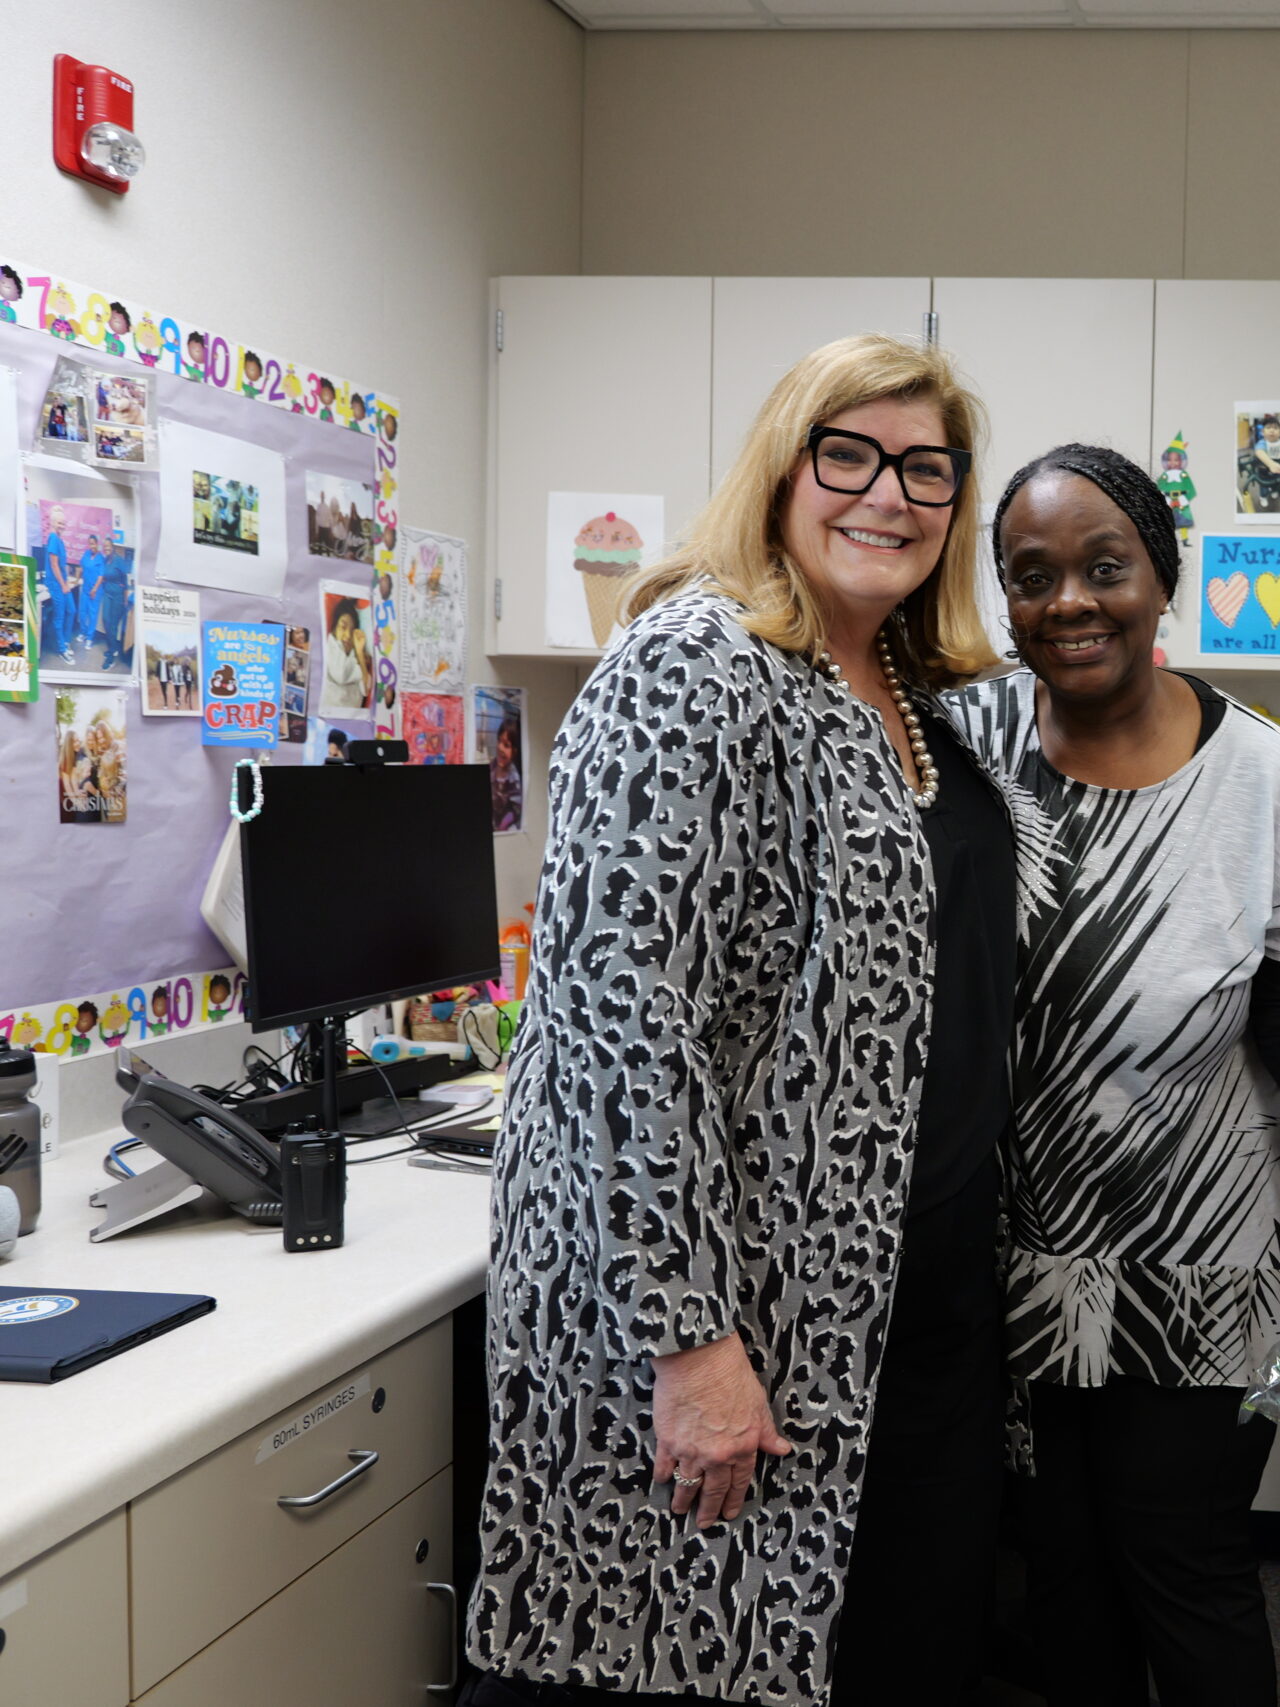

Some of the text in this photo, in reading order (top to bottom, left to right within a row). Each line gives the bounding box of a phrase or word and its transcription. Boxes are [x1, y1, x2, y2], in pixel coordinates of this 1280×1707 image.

[110, 76, 133, 93] FIRE
[76, 87, 85, 120] FIRE
[27, 277, 51, 329] 7
[80, 293, 112, 345] 8
[160, 317, 182, 375] 9
[203, 332, 230, 388] 10
[265, 360, 286, 401] 2
[304, 373, 321, 414] 3
[142, 589, 180, 604] happiest
[142, 603, 180, 618] holidays
[207, 627, 280, 645] Nurses
[1212, 636, 1243, 649] are
[1251, 634, 1276, 649] all
[223, 642, 241, 650] are
[216, 646, 271, 665] angels
[205, 700, 277, 729] CRAP.
[46, 1004, 79, 1055] 8
[127, 987, 147, 1040] 9
[166, 977, 193, 1033] 10
[273, 1386, 355, 1449] 60mL SYRINGES
